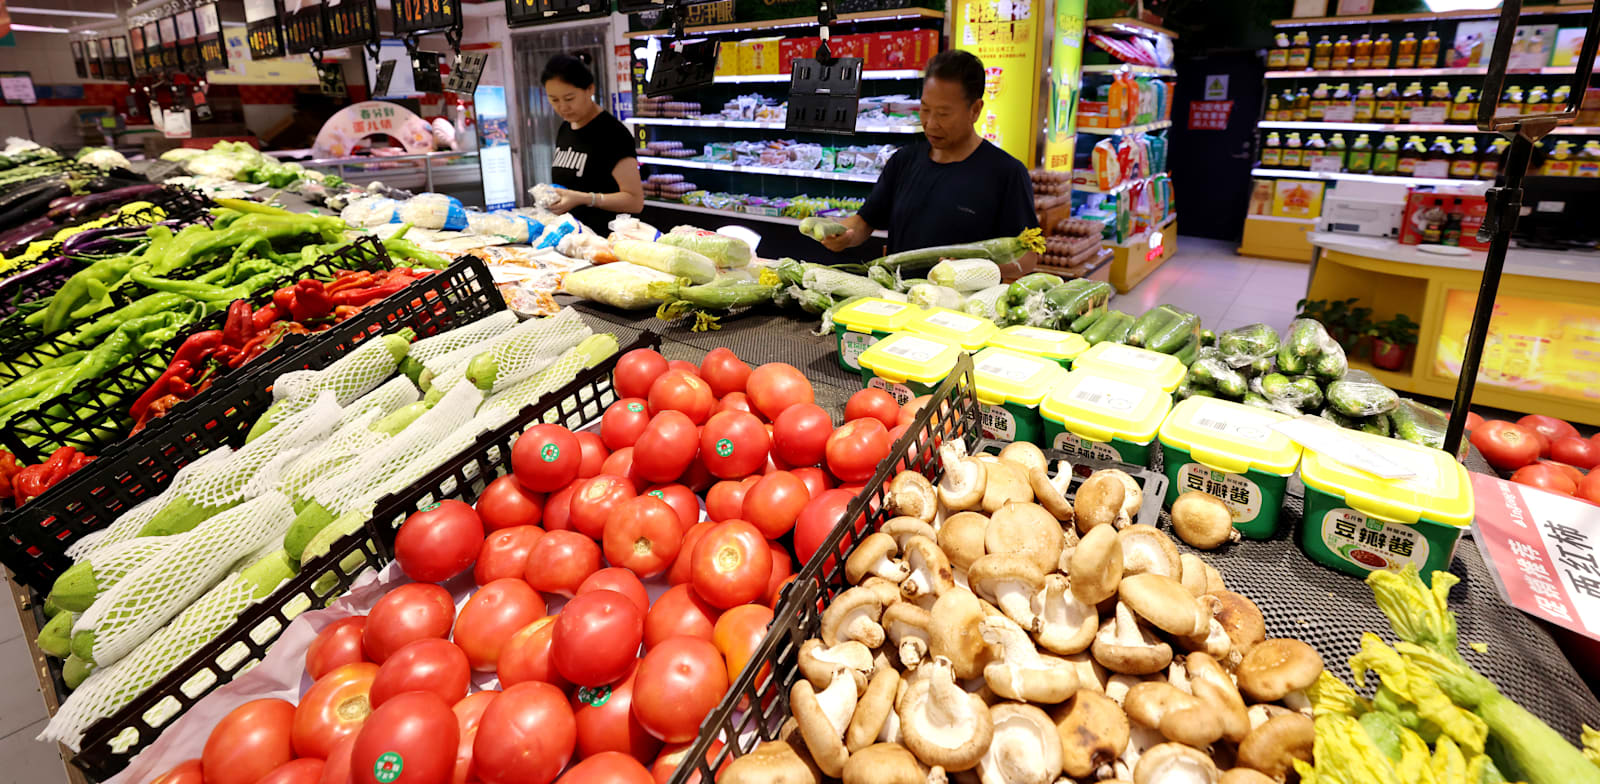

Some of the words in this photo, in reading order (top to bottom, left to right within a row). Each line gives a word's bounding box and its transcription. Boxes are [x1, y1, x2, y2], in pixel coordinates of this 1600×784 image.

[1187, 472, 1250, 505] 豆瓣酱
[1334, 518, 1415, 558] 豆瓣酱
[1543, 520, 1600, 599] 西红柿
[1508, 538, 1573, 622] 促销推荐
